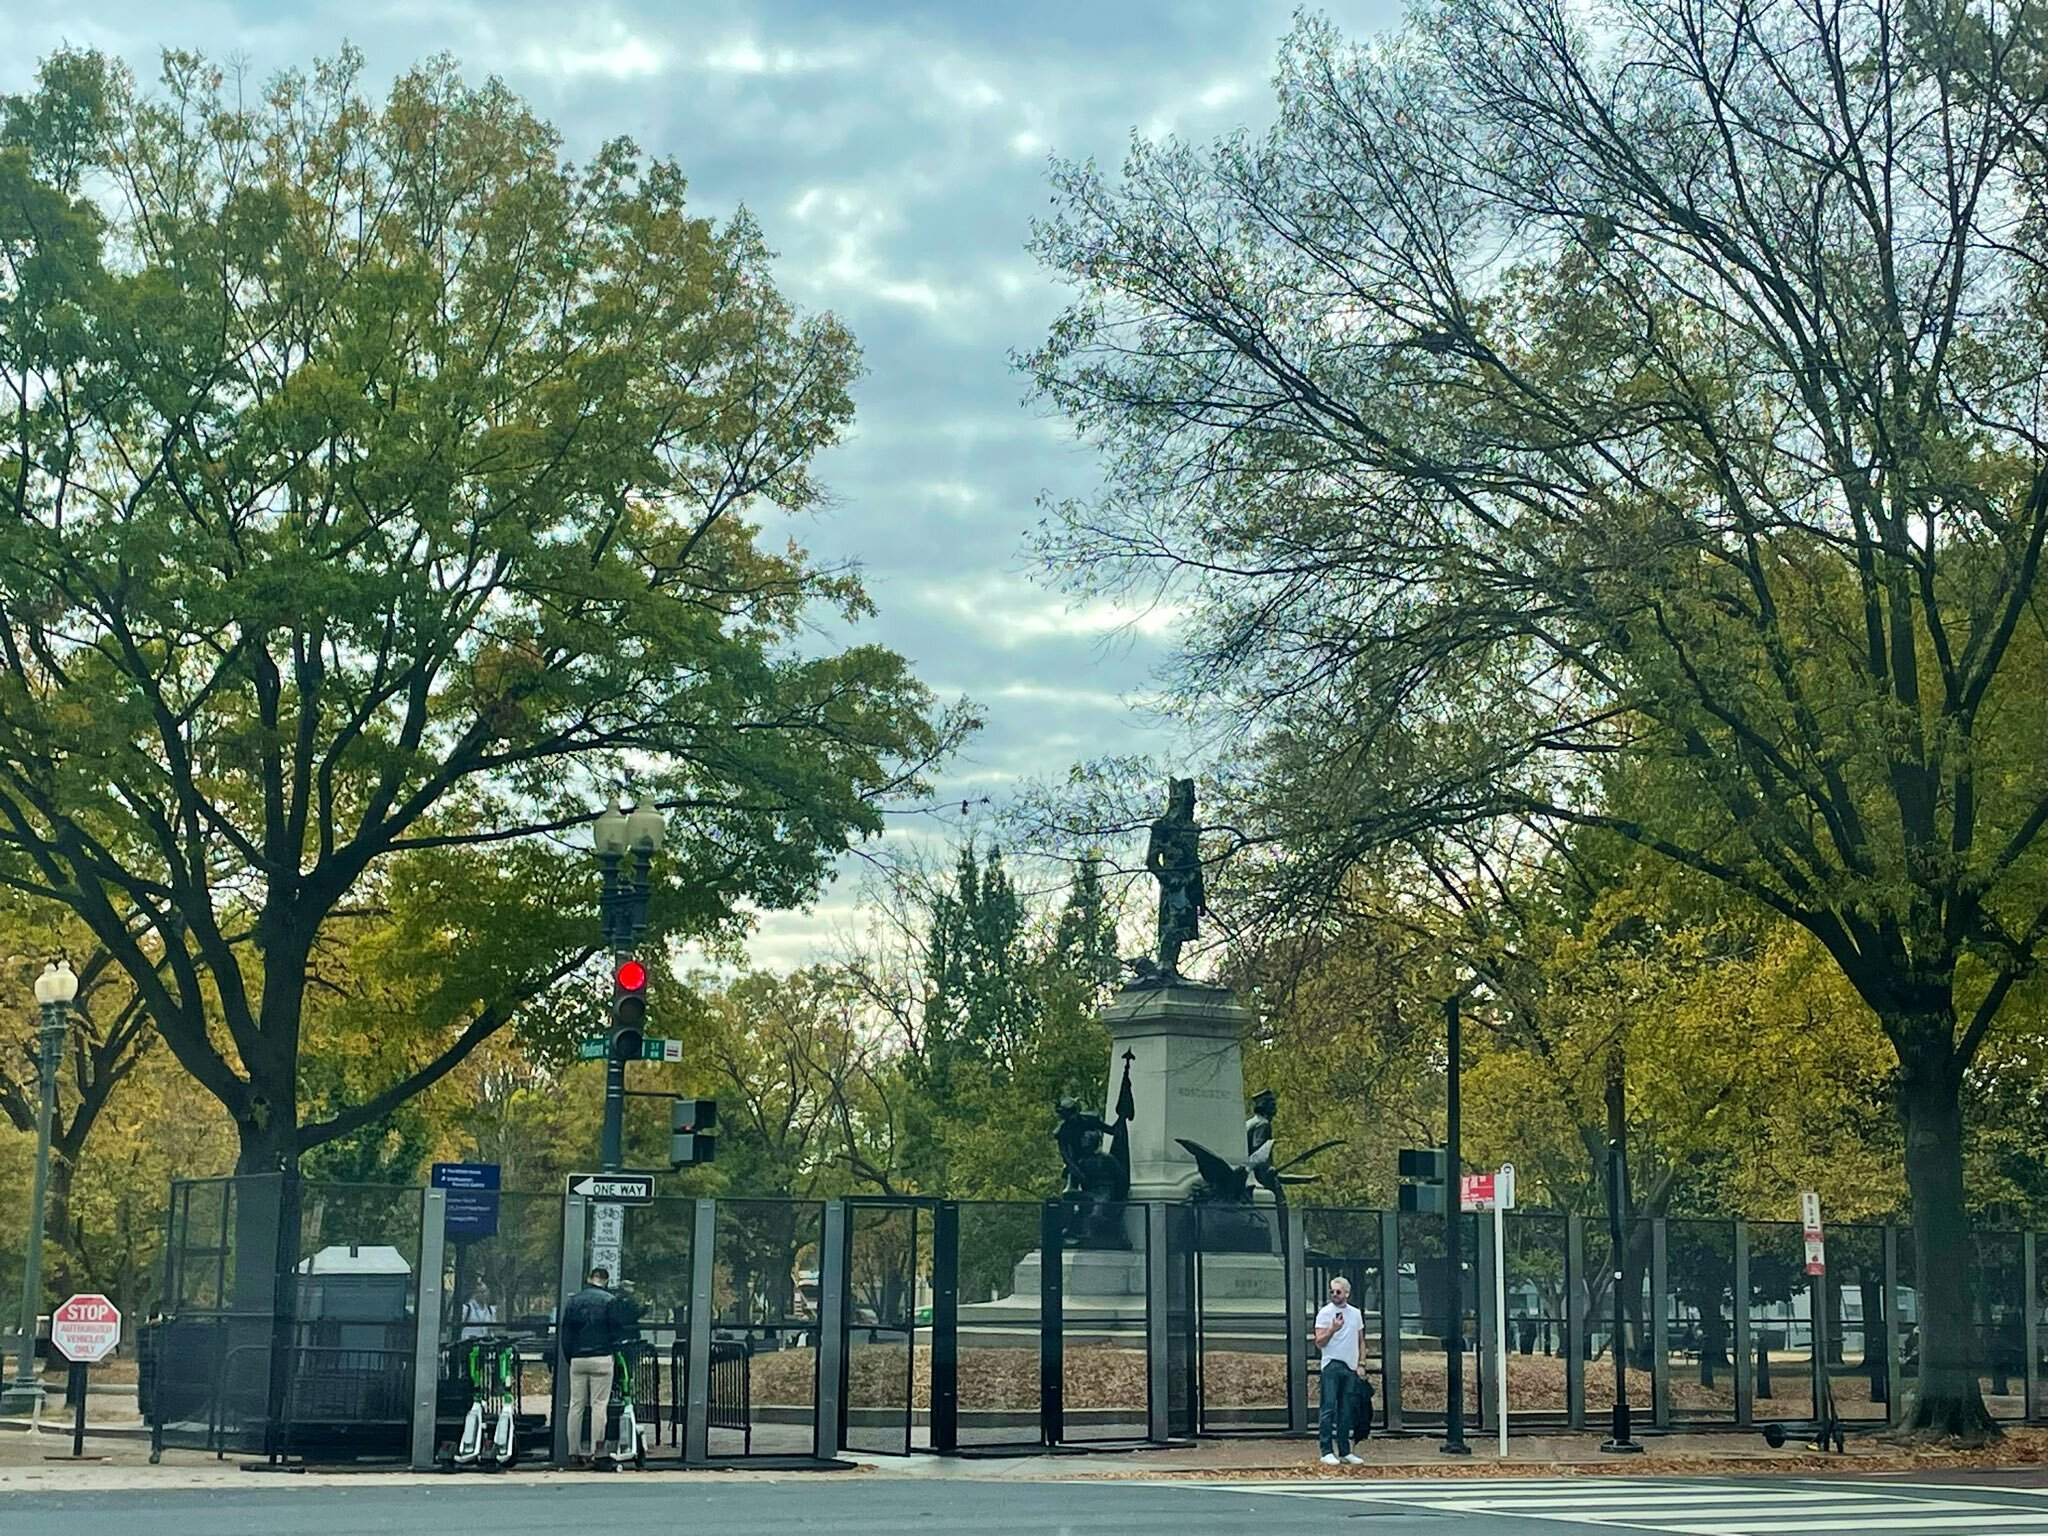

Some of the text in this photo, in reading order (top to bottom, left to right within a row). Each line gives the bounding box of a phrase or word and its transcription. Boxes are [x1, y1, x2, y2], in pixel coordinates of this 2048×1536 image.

[650, 1042, 660, 1050] ST
[593, 1184, 644, 1196] ONE WAY
[67, 1304, 109, 1321] STOP
[66, 1334, 106, 1343] VEHICLES
[74, 1345, 96, 1354] ONLY
